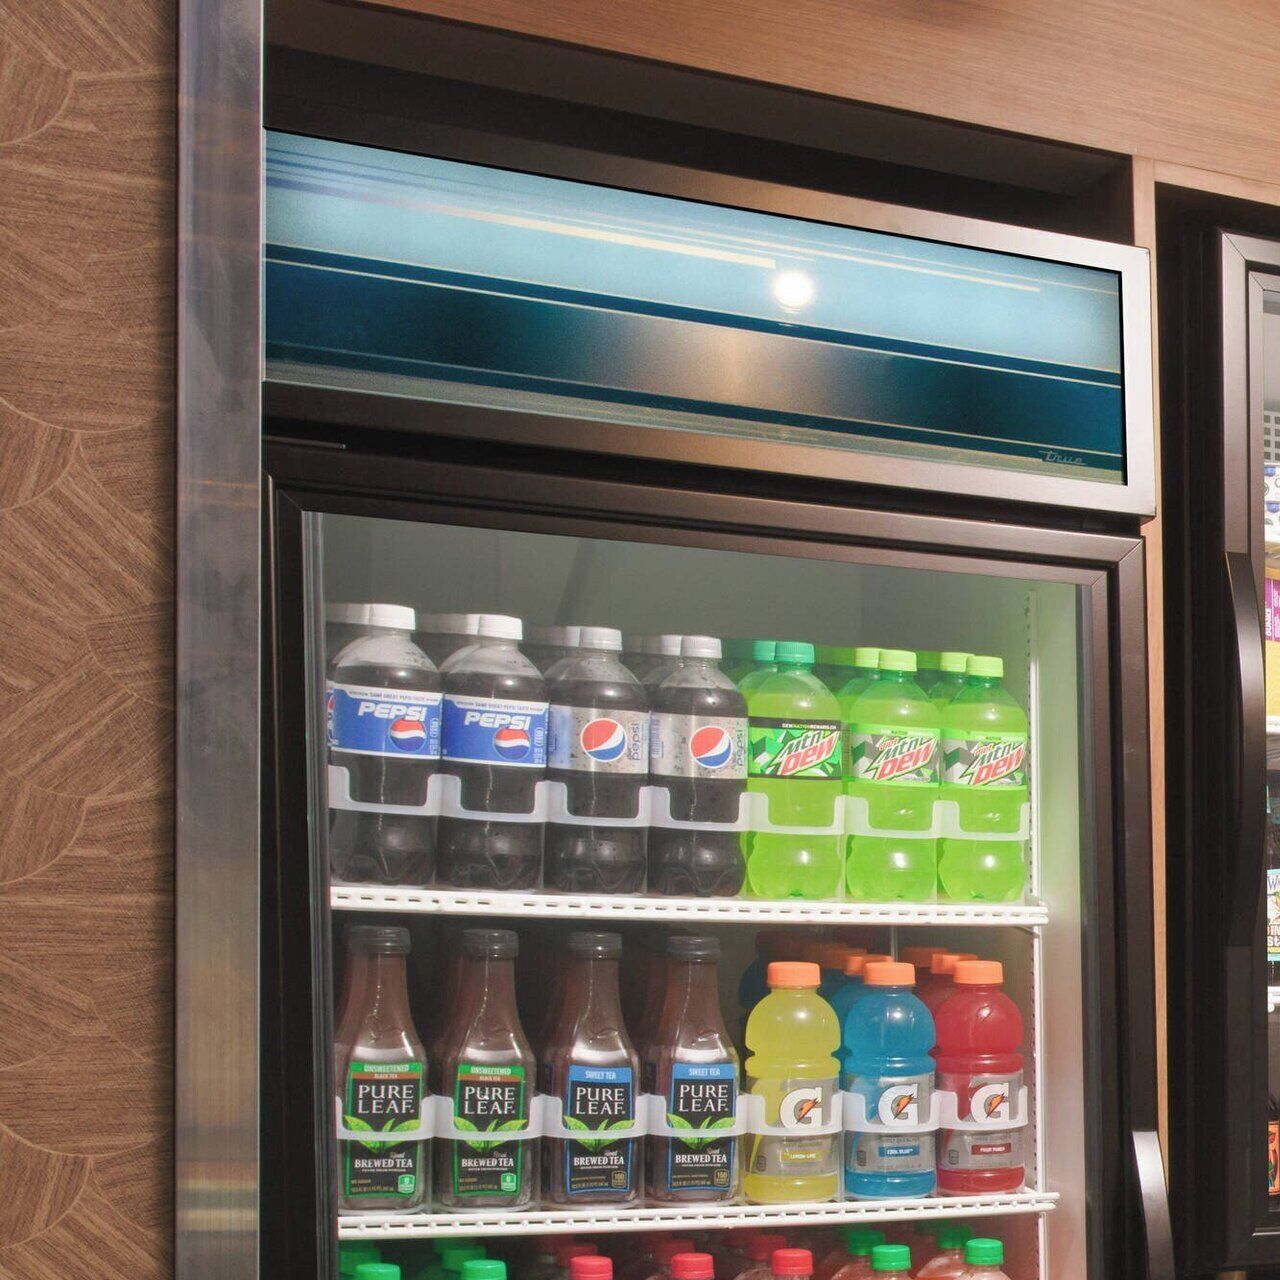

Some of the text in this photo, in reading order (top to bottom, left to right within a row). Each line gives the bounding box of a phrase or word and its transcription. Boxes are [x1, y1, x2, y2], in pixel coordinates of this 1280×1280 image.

[358, 702, 427, 721] PEPSI
[464, 711, 531, 730] PEPSI
[631, 722, 641, 761] pepsi
[604, 1071, 616, 1079] TEA
[709, 1067, 720, 1076] TEA
[358, 1084, 414, 1099] PURE
[464, 1087, 515, 1100] PURE
[576, 1087, 624, 1101] PURE
[680, 1084, 728, 1098] PURE
[779, 1086, 823, 1128] G
[878, 1084, 919, 1126] G
[971, 1083, 1010, 1123] G
[355, 1158, 413, 1168] BREWED TEA
[461, 1157, 514, 1167] BREWED TEA
[573, 1156, 624, 1166] BREWED TEA
[675, 1154, 727, 1164] BREWED TEA
